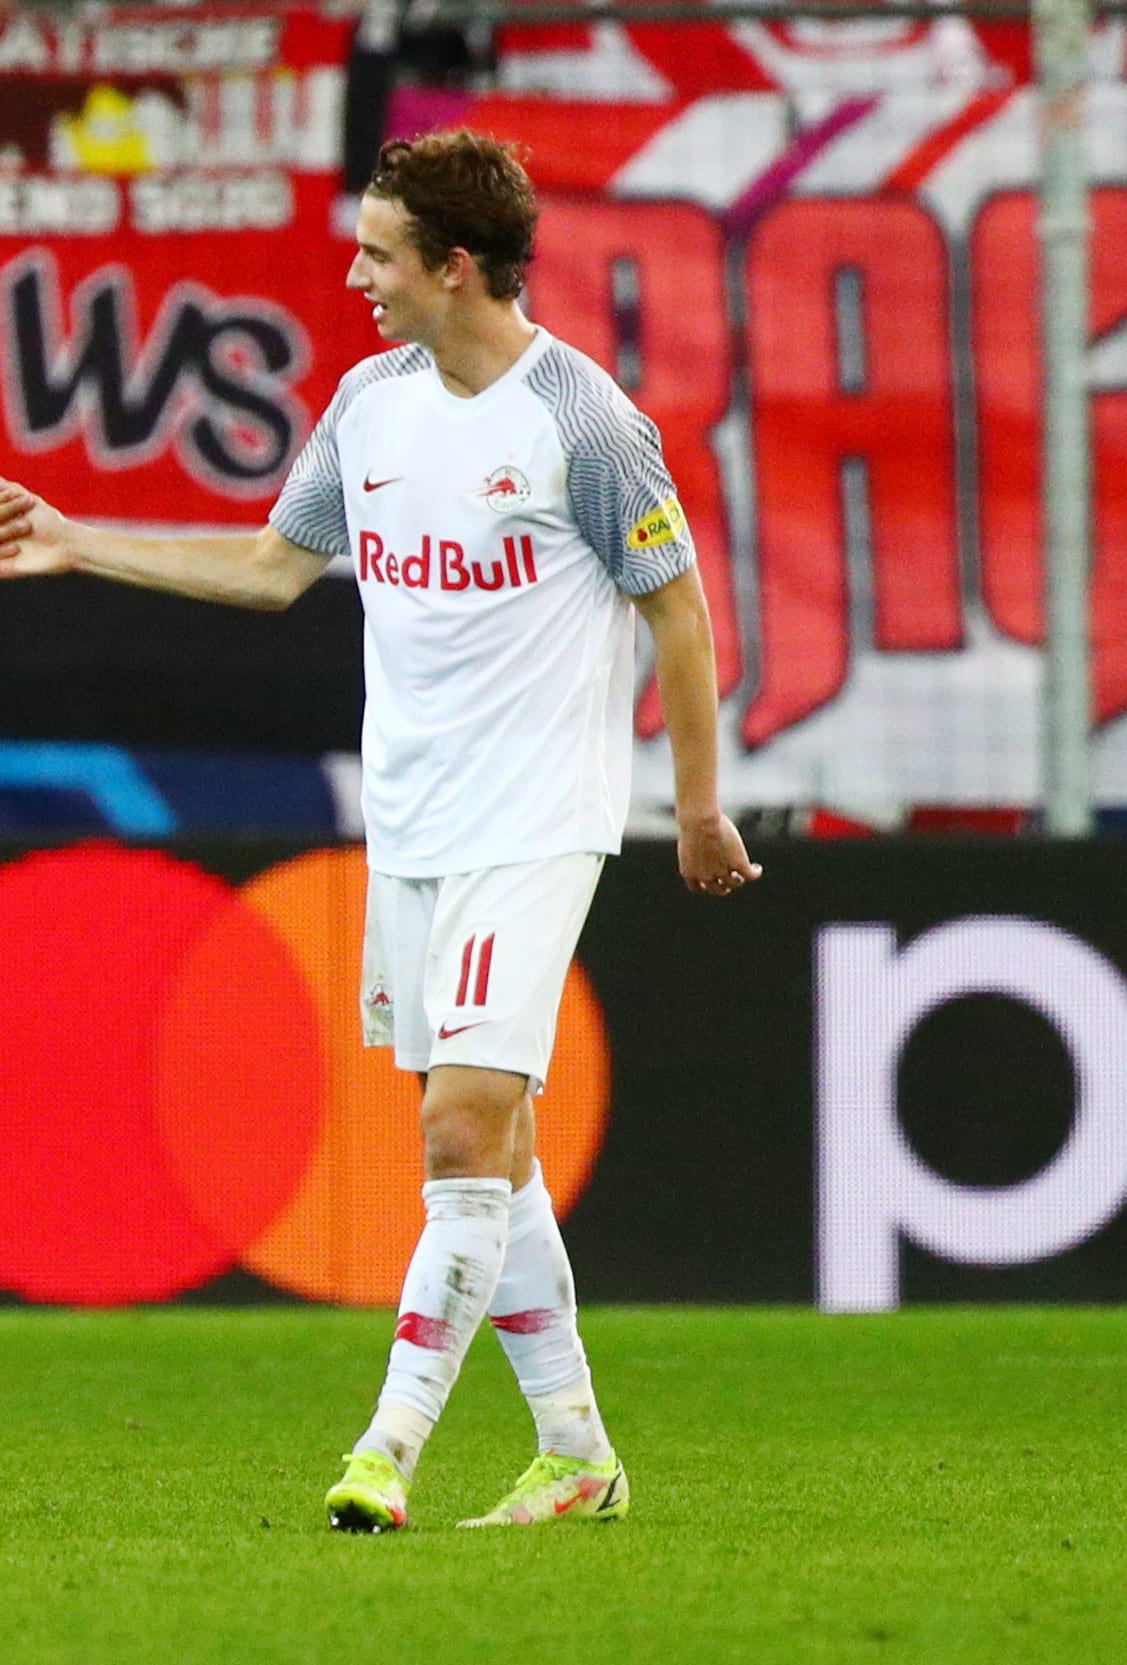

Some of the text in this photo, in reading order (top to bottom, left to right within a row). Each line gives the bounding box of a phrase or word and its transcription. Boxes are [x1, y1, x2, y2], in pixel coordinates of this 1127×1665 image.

[359, 530, 539, 591] Red Bull
[455, 931, 495, 1007] 11
[813, 914, 1127, 1313] p
